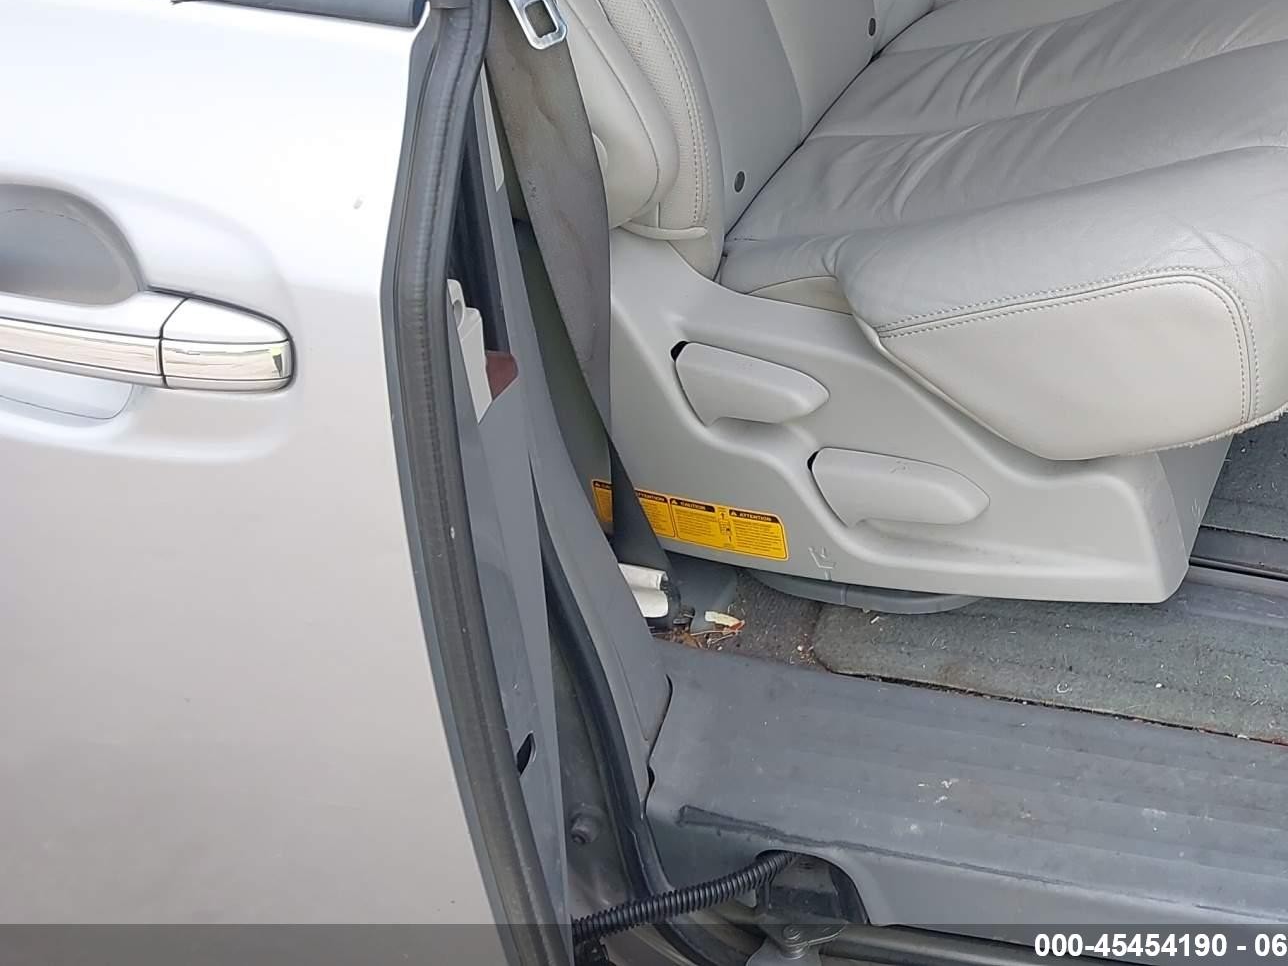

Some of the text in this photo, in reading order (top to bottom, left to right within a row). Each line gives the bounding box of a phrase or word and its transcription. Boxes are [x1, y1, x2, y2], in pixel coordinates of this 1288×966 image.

[637, 491, 665, 502] TTENTION
[680, 501, 706, 511] CAUTION
[740, 512, 772, 522] ATTENTION
